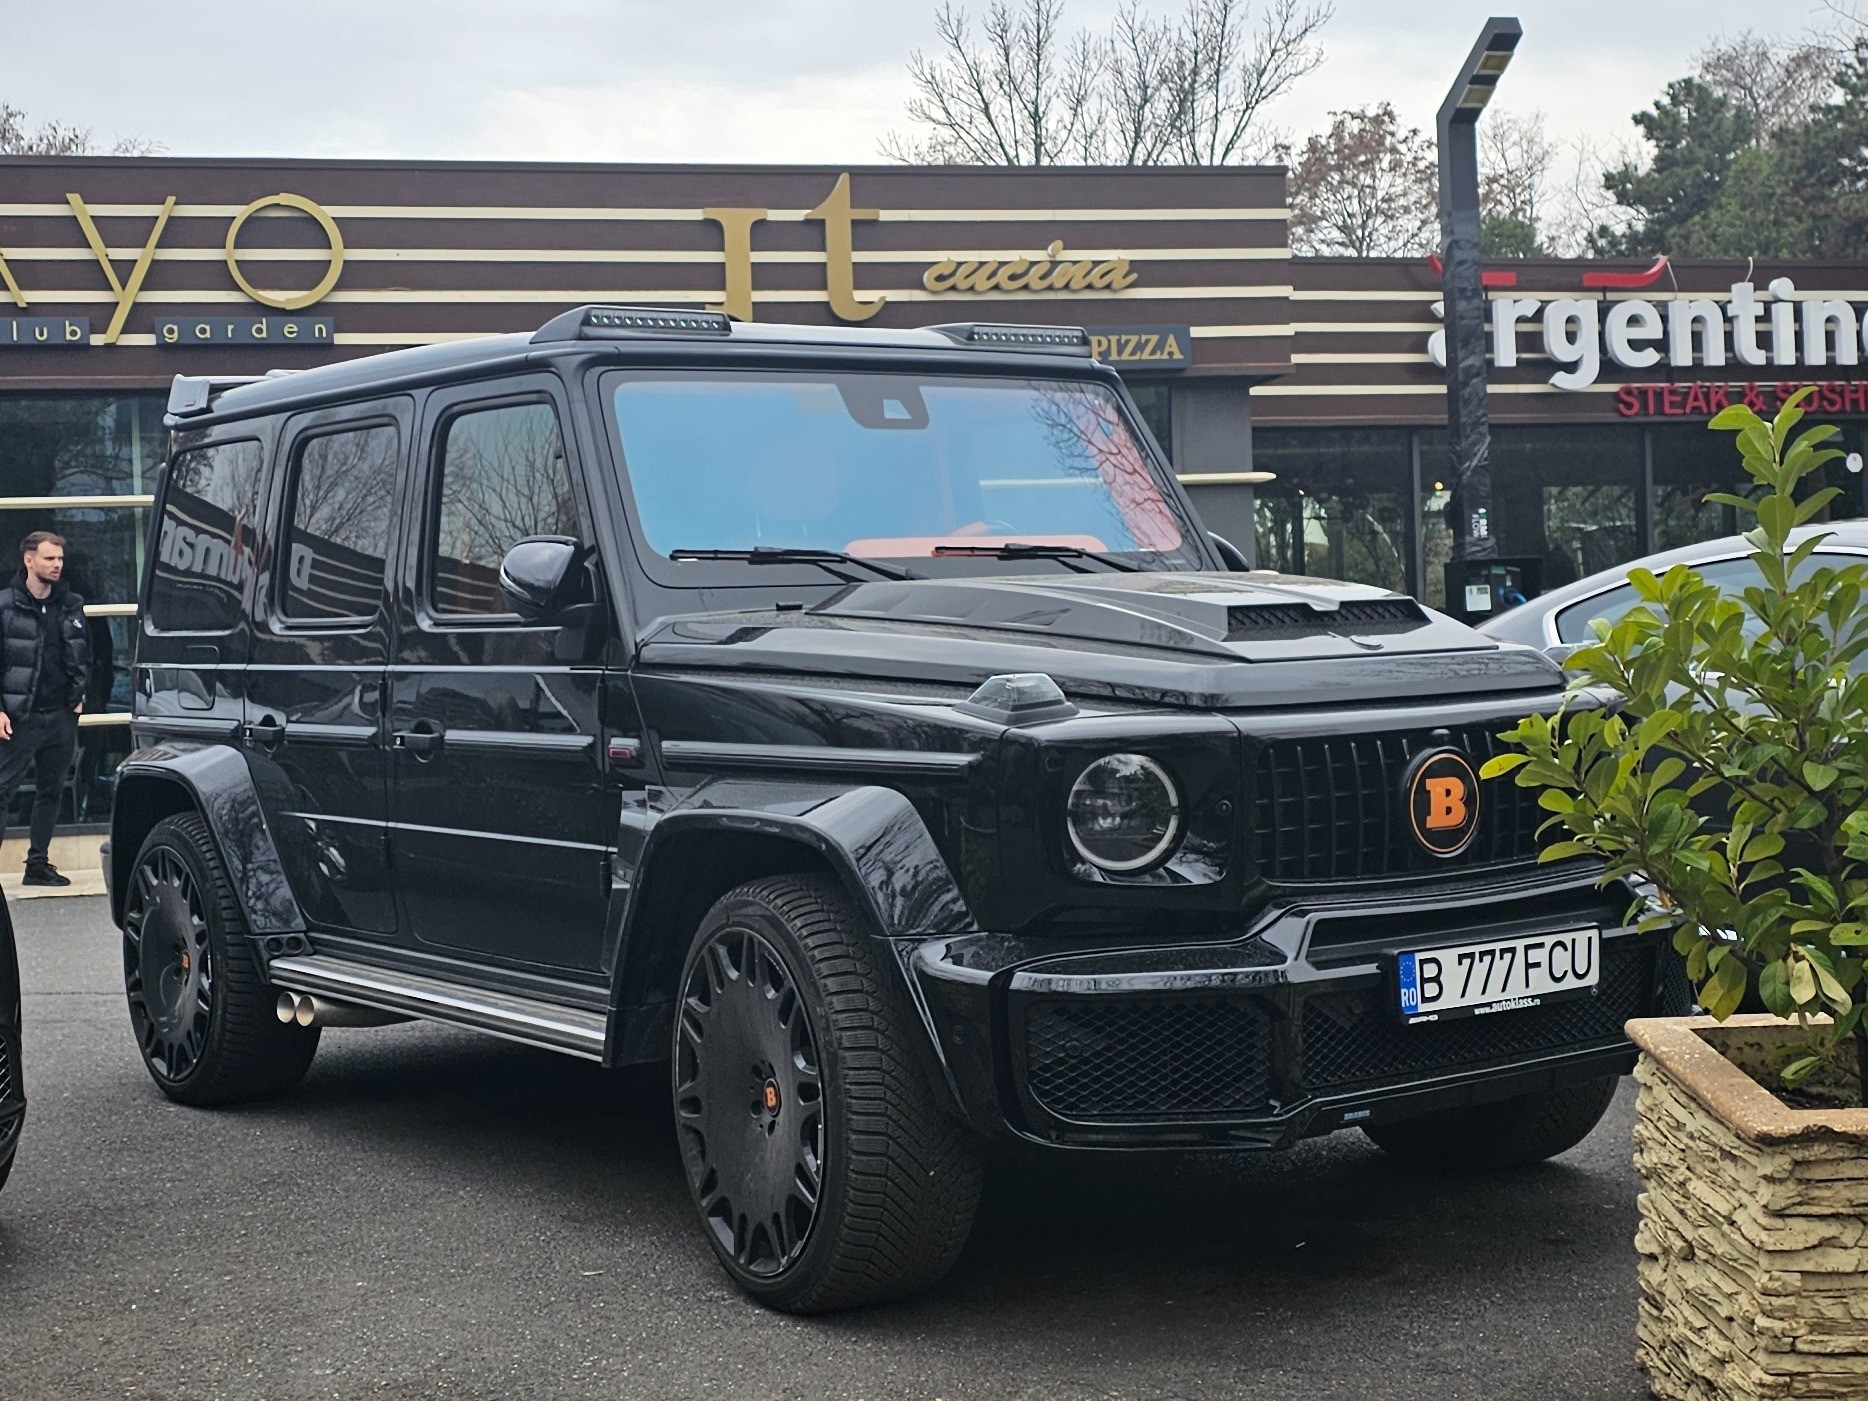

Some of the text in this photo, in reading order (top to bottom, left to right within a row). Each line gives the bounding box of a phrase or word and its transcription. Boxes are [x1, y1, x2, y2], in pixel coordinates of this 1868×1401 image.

[922, 239, 1139, 293] cucina
[163, 317, 327, 343] garden
[1090, 333, 1185, 361] PIZZA
[1428, 276, 1868, 391] rgentin
[1617, 380, 1868, 416] STEAK & SUSH
[1425, 776, 1468, 831] B
[1400, 987, 1418, 1008] RO
[1418, 956, 1444, 1005] B
